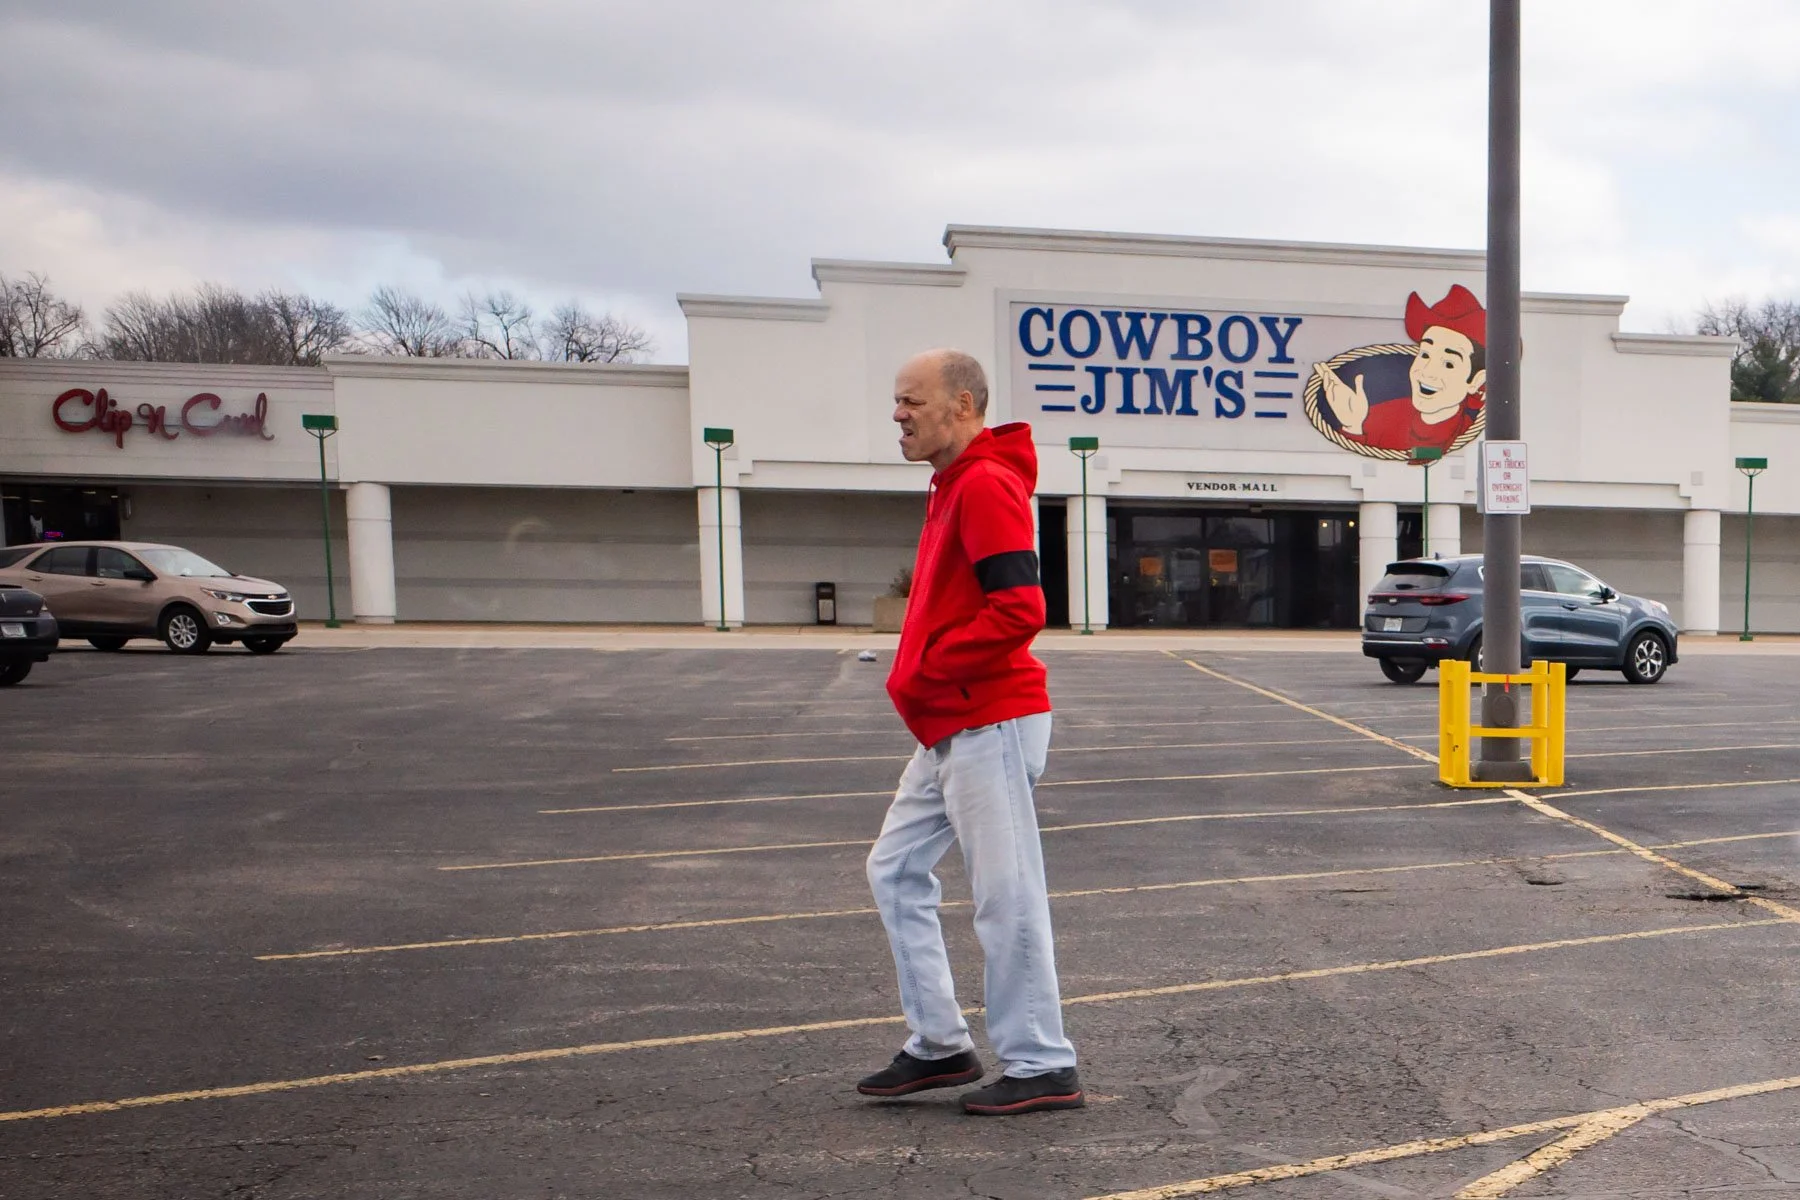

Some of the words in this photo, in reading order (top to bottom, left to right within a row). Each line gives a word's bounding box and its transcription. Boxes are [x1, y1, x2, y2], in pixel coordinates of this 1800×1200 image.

[1018, 307, 1303, 364] COWBOY
[1080, 365, 1245, 419] JIM'S
[52, 387, 133, 449] Clip
[1503, 449, 1511, 457] NO
[1488, 461, 1501, 469] SEMI
[1504, 461, 1525, 469] TRUCKS
[1503, 472, 1511, 480] OR
[1186, 482, 1237, 491] VENDOR
[1241, 483, 1278, 492] MALL
[1492, 483, 1522, 491] OVERNIGHT
[1496, 495, 1519, 503] PARKING
